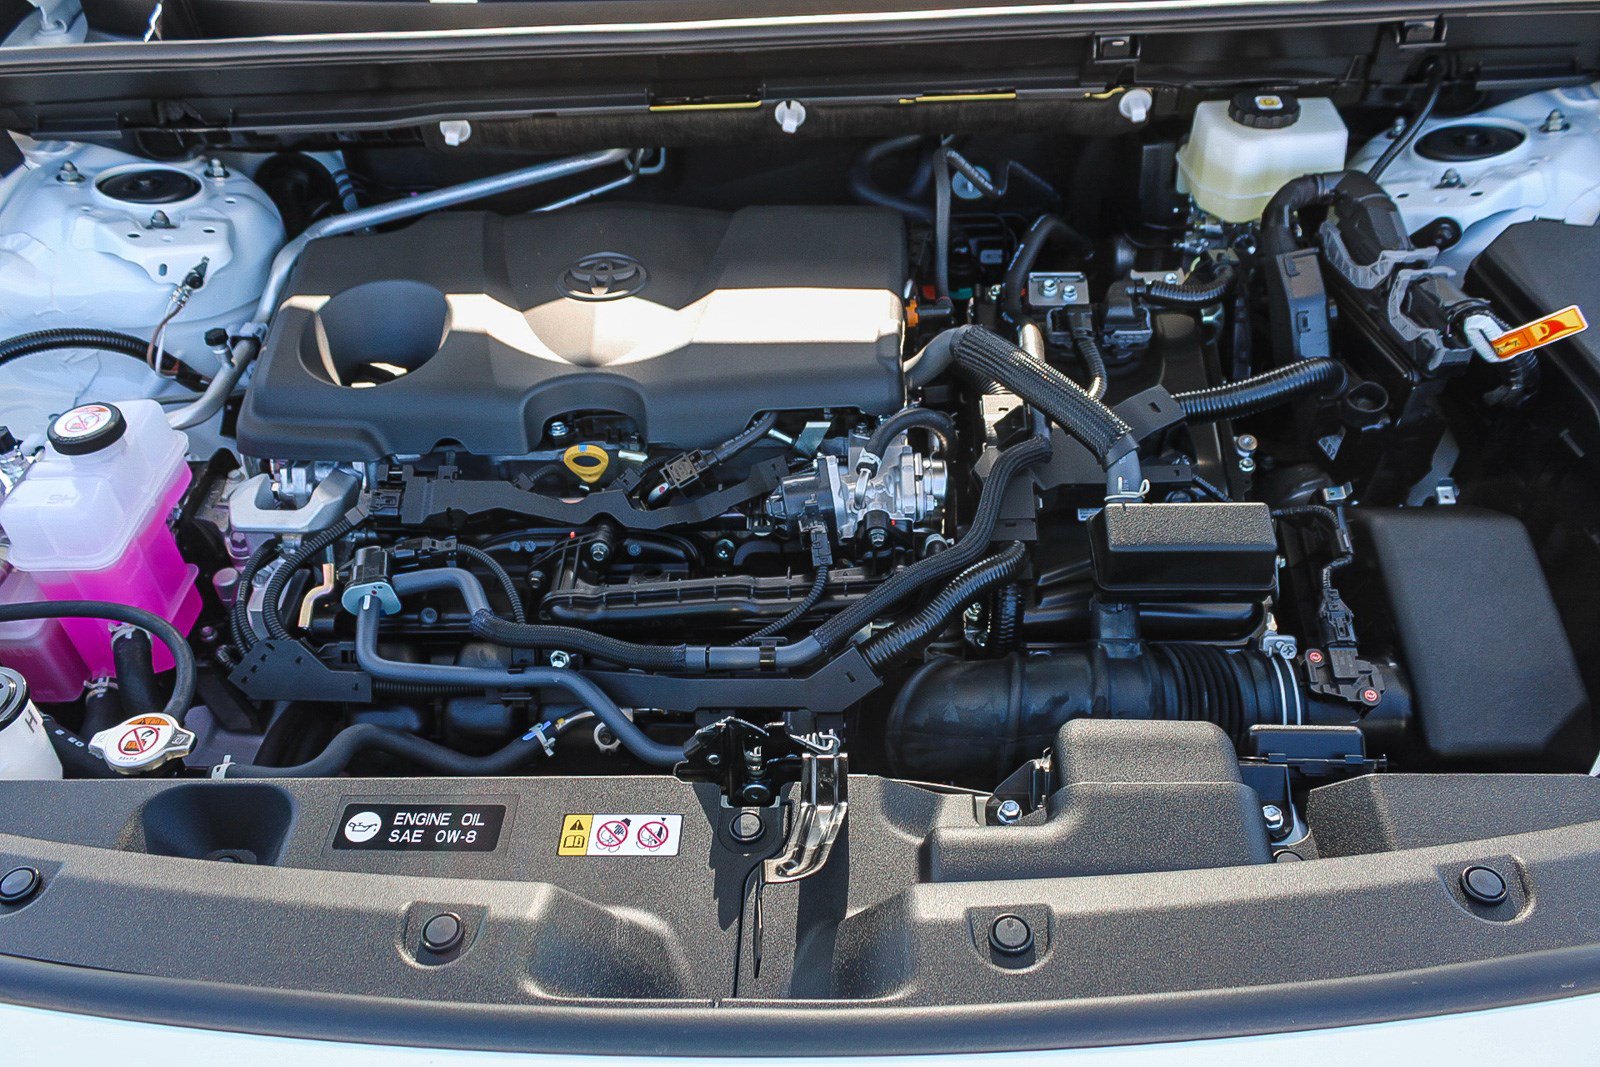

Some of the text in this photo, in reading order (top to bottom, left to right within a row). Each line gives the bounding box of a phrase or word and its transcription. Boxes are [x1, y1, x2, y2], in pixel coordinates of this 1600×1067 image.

[393, 812, 485, 827] ENGINE OIL
[387, 829, 478, 844] SAE 0W-8
